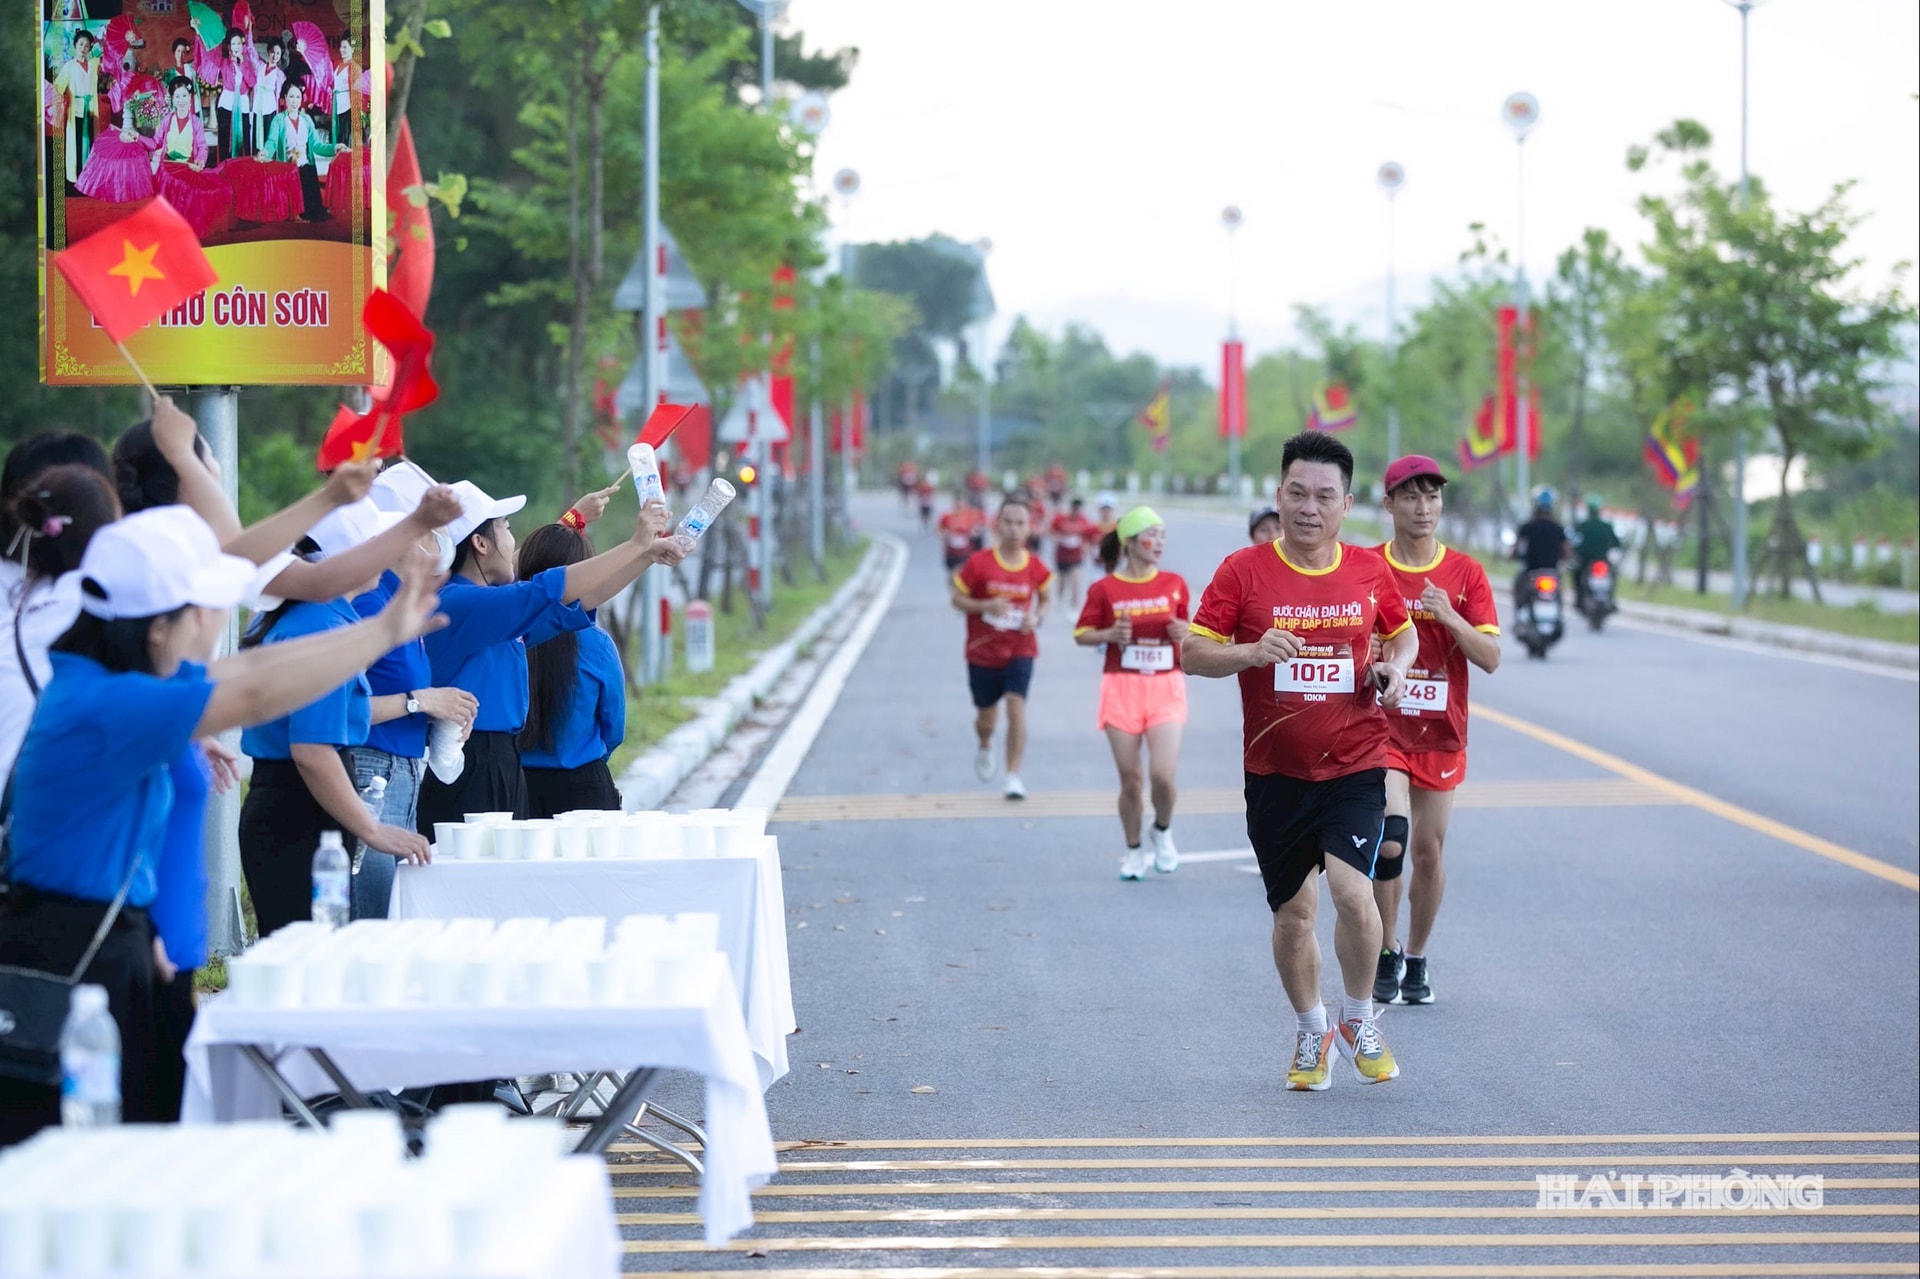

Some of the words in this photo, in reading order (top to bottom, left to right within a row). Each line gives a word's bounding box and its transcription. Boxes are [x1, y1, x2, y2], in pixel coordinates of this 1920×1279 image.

[214, 285, 267, 327] CÔN
[274, 288, 329, 328] SƠN
[1295, 605, 1319, 618] CHÂN
[1321, 605, 1340, 620] ĐẠI
[1342, 601, 1361, 620] HỘI
[1274, 617, 1300, 631] NHỊP
[1302, 616, 1322, 631] ĐẬP
[1290, 663, 1340, 682] 1012
[1303, 693, 1327, 702] 10KM
[1400, 708, 1420, 717] 10KM
